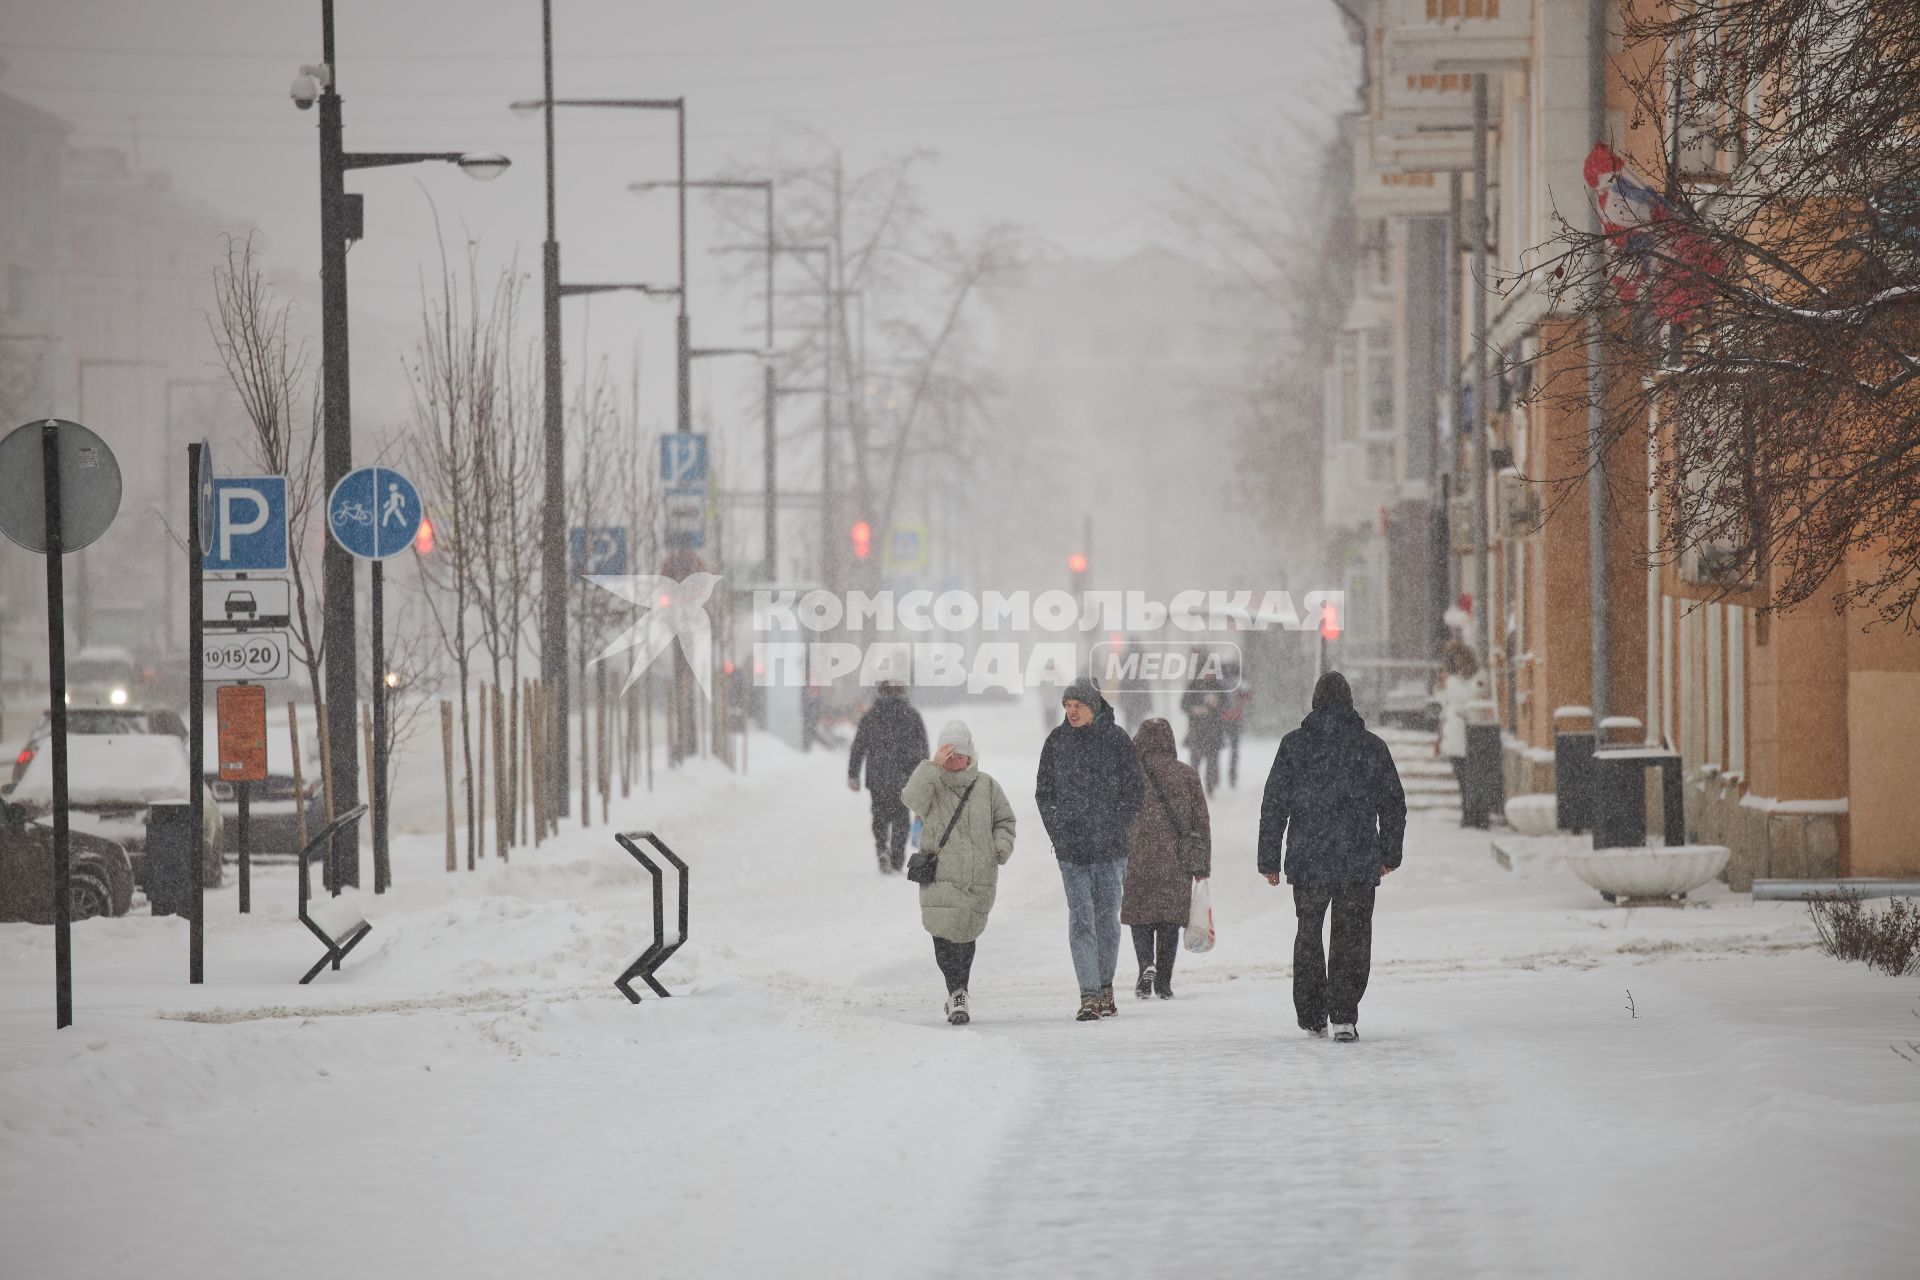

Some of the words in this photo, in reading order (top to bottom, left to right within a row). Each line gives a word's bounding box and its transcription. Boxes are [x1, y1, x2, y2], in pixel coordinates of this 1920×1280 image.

[220, 487, 270, 561] P
[205, 651, 219, 663] 10
[224, 649, 242, 663] 15
[249, 647, 271, 664] 20
